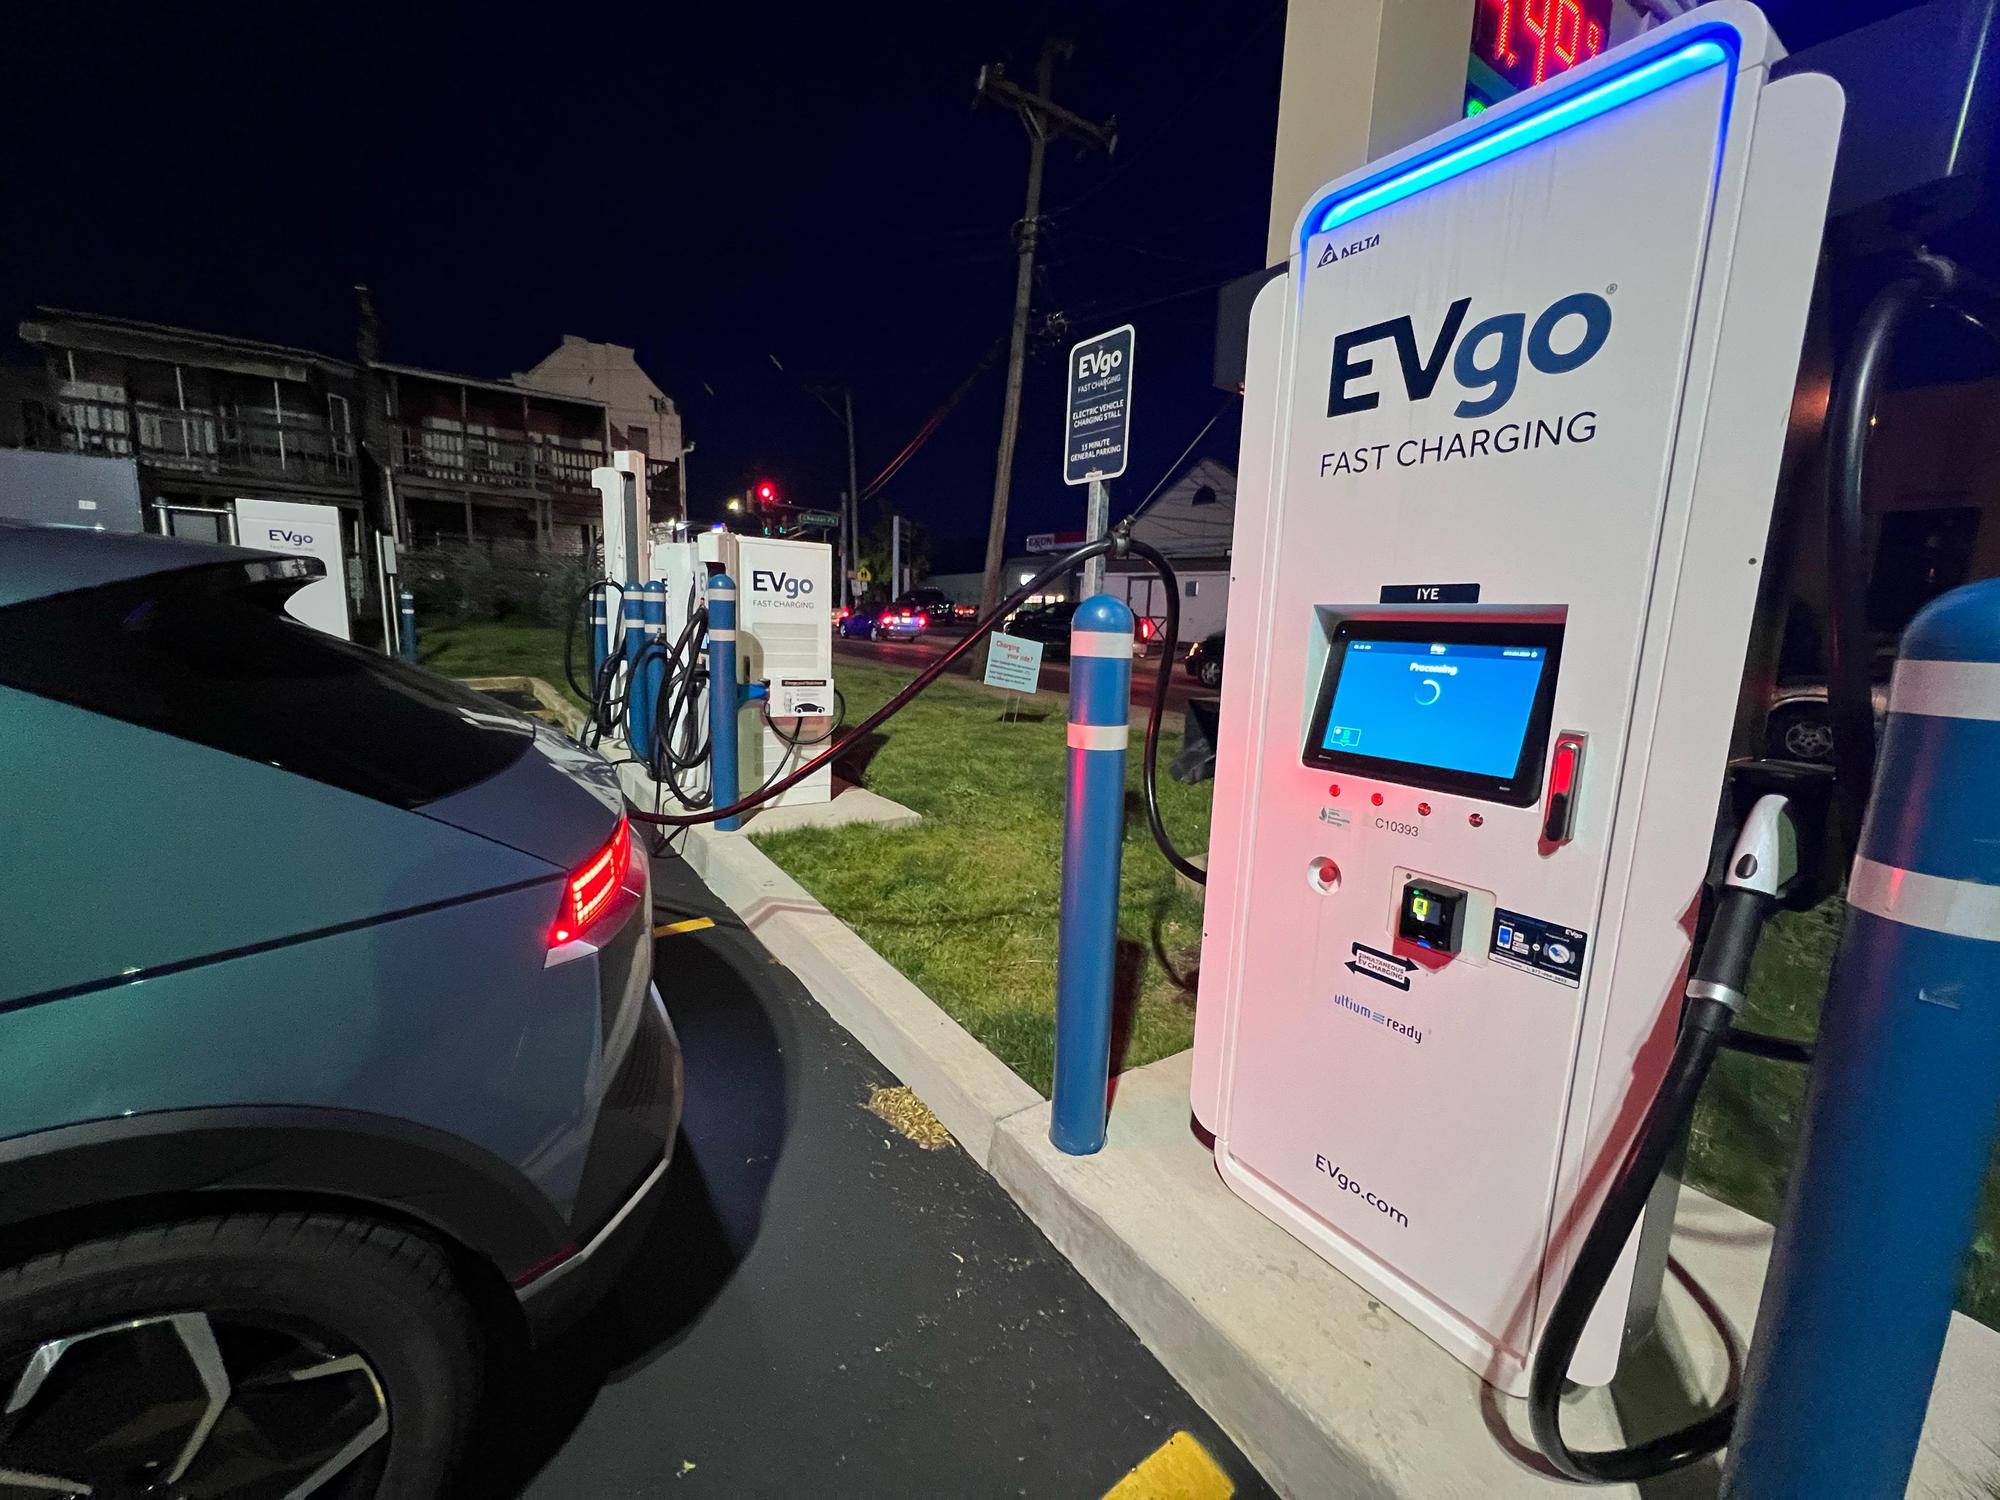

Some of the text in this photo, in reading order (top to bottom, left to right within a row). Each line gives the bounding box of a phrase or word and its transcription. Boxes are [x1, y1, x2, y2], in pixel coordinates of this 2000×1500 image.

[1341, 233, 1380, 259] DELTA
[1079, 350, 1122, 379] EVgo
[1078, 374, 1121, 393] FAST CHARGING
[1073, 399, 1124, 420] ELECTRIC VEHICLE
[1073, 409, 1121, 428] CHARGING STALL
[1070, 444, 1121, 462] GENERAL PARKING
[1081, 438, 1110, 452] 15 MINUTE
[1320, 411, 1597, 477] FAST CHARGING
[269, 529, 313, 546] EVgo
[753, 570, 814, 599] EVgo
[1417, 588, 1440, 600] IYE
[753, 600, 815, 609] FAST CHARGING
[1409, 662, 1459, 676] Processing
[1375, 817, 1419, 837] C10393
[1565, 928, 1583, 939] EVgo
[1358, 952, 1404, 975] SIMULTANEOUS
[1358, 957, 1403, 980] EV CHARGING
[1334, 993, 1422, 1044] ultium ready
[1315, 1153, 1408, 1228] EVgo.com
